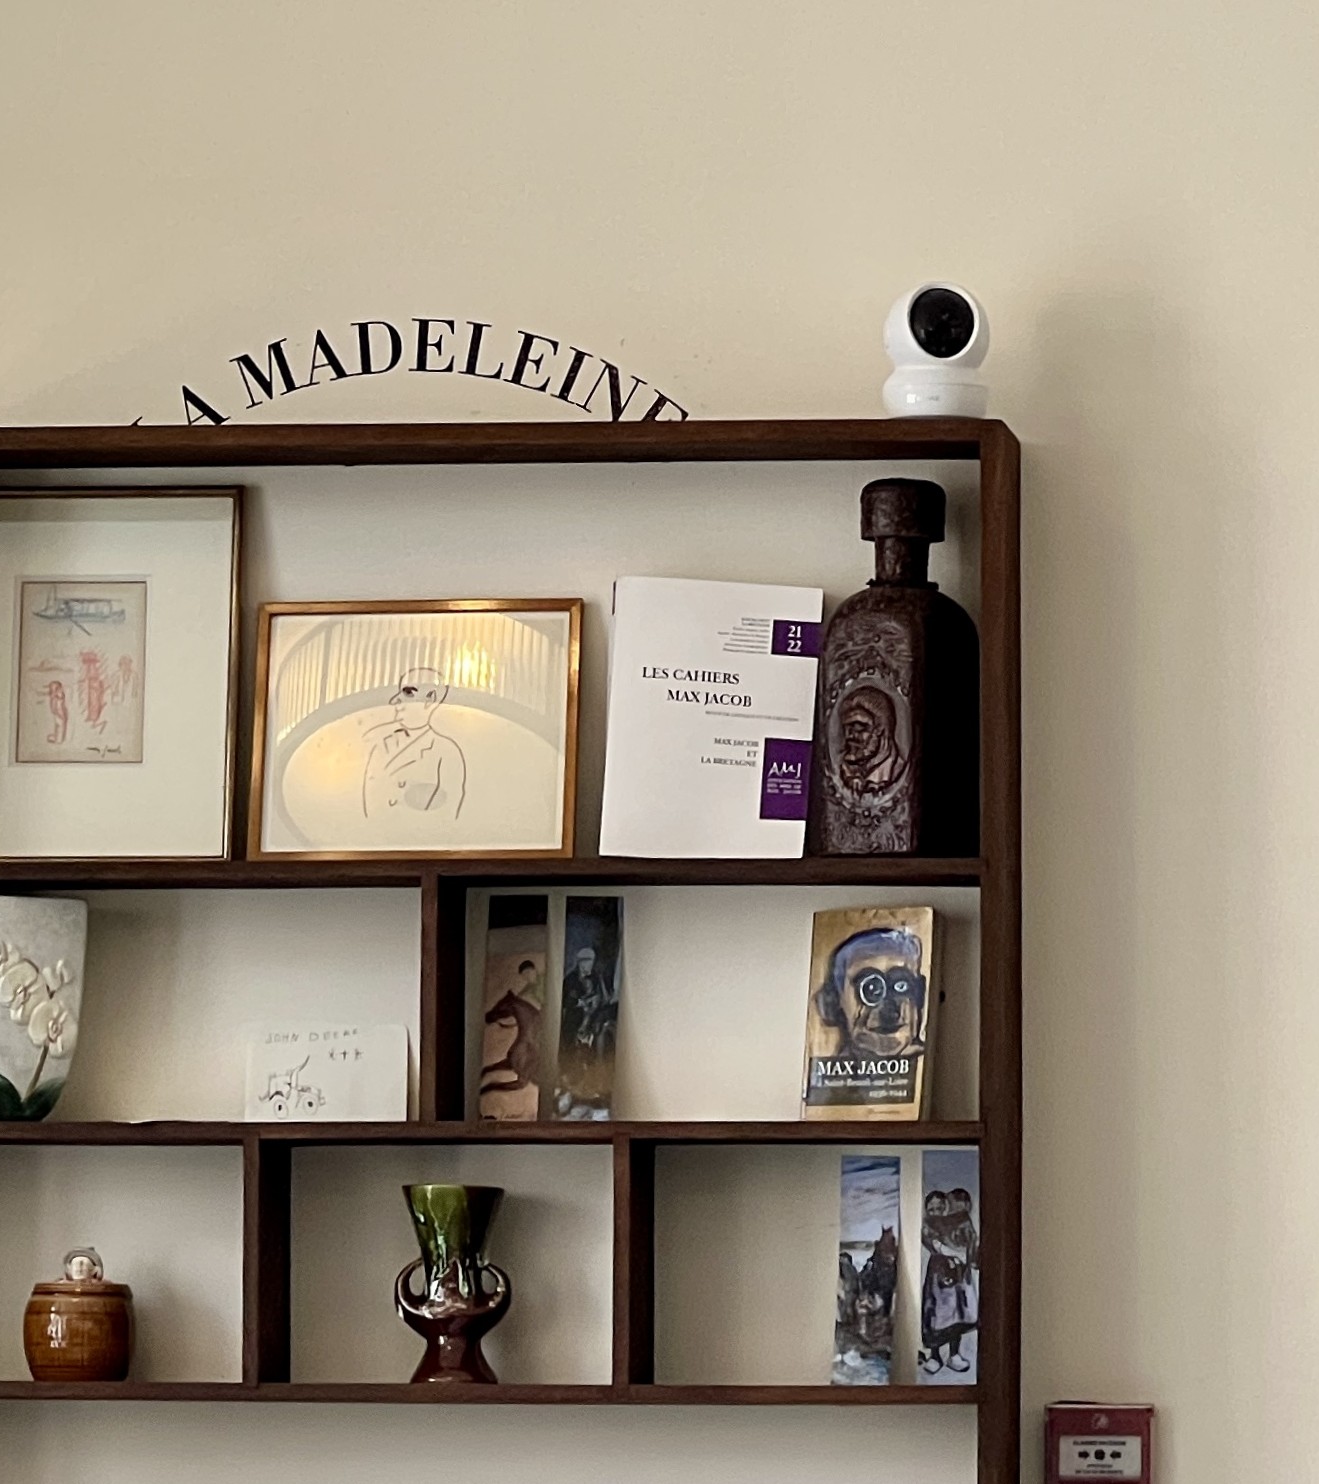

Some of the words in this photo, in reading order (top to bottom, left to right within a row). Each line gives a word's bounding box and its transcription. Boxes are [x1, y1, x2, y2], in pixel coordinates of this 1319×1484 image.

[787, 625, 802, 638] 21
[787, 640, 802, 652] 22
[642, 666, 669, 680] LES
[673, 668, 740, 685] CAHIERS
[667, 689, 700, 703] MAX
[703, 692, 752, 708] JACOB
[714, 738, 732, 746] MAX
[746, 750, 758, 758] ET
[700, 756, 712, 764] LA
[713, 757, 756, 767] BRETAGNE
[818, 1060, 854, 1076] MAX
[857, 1059, 910, 1075] JACOB
